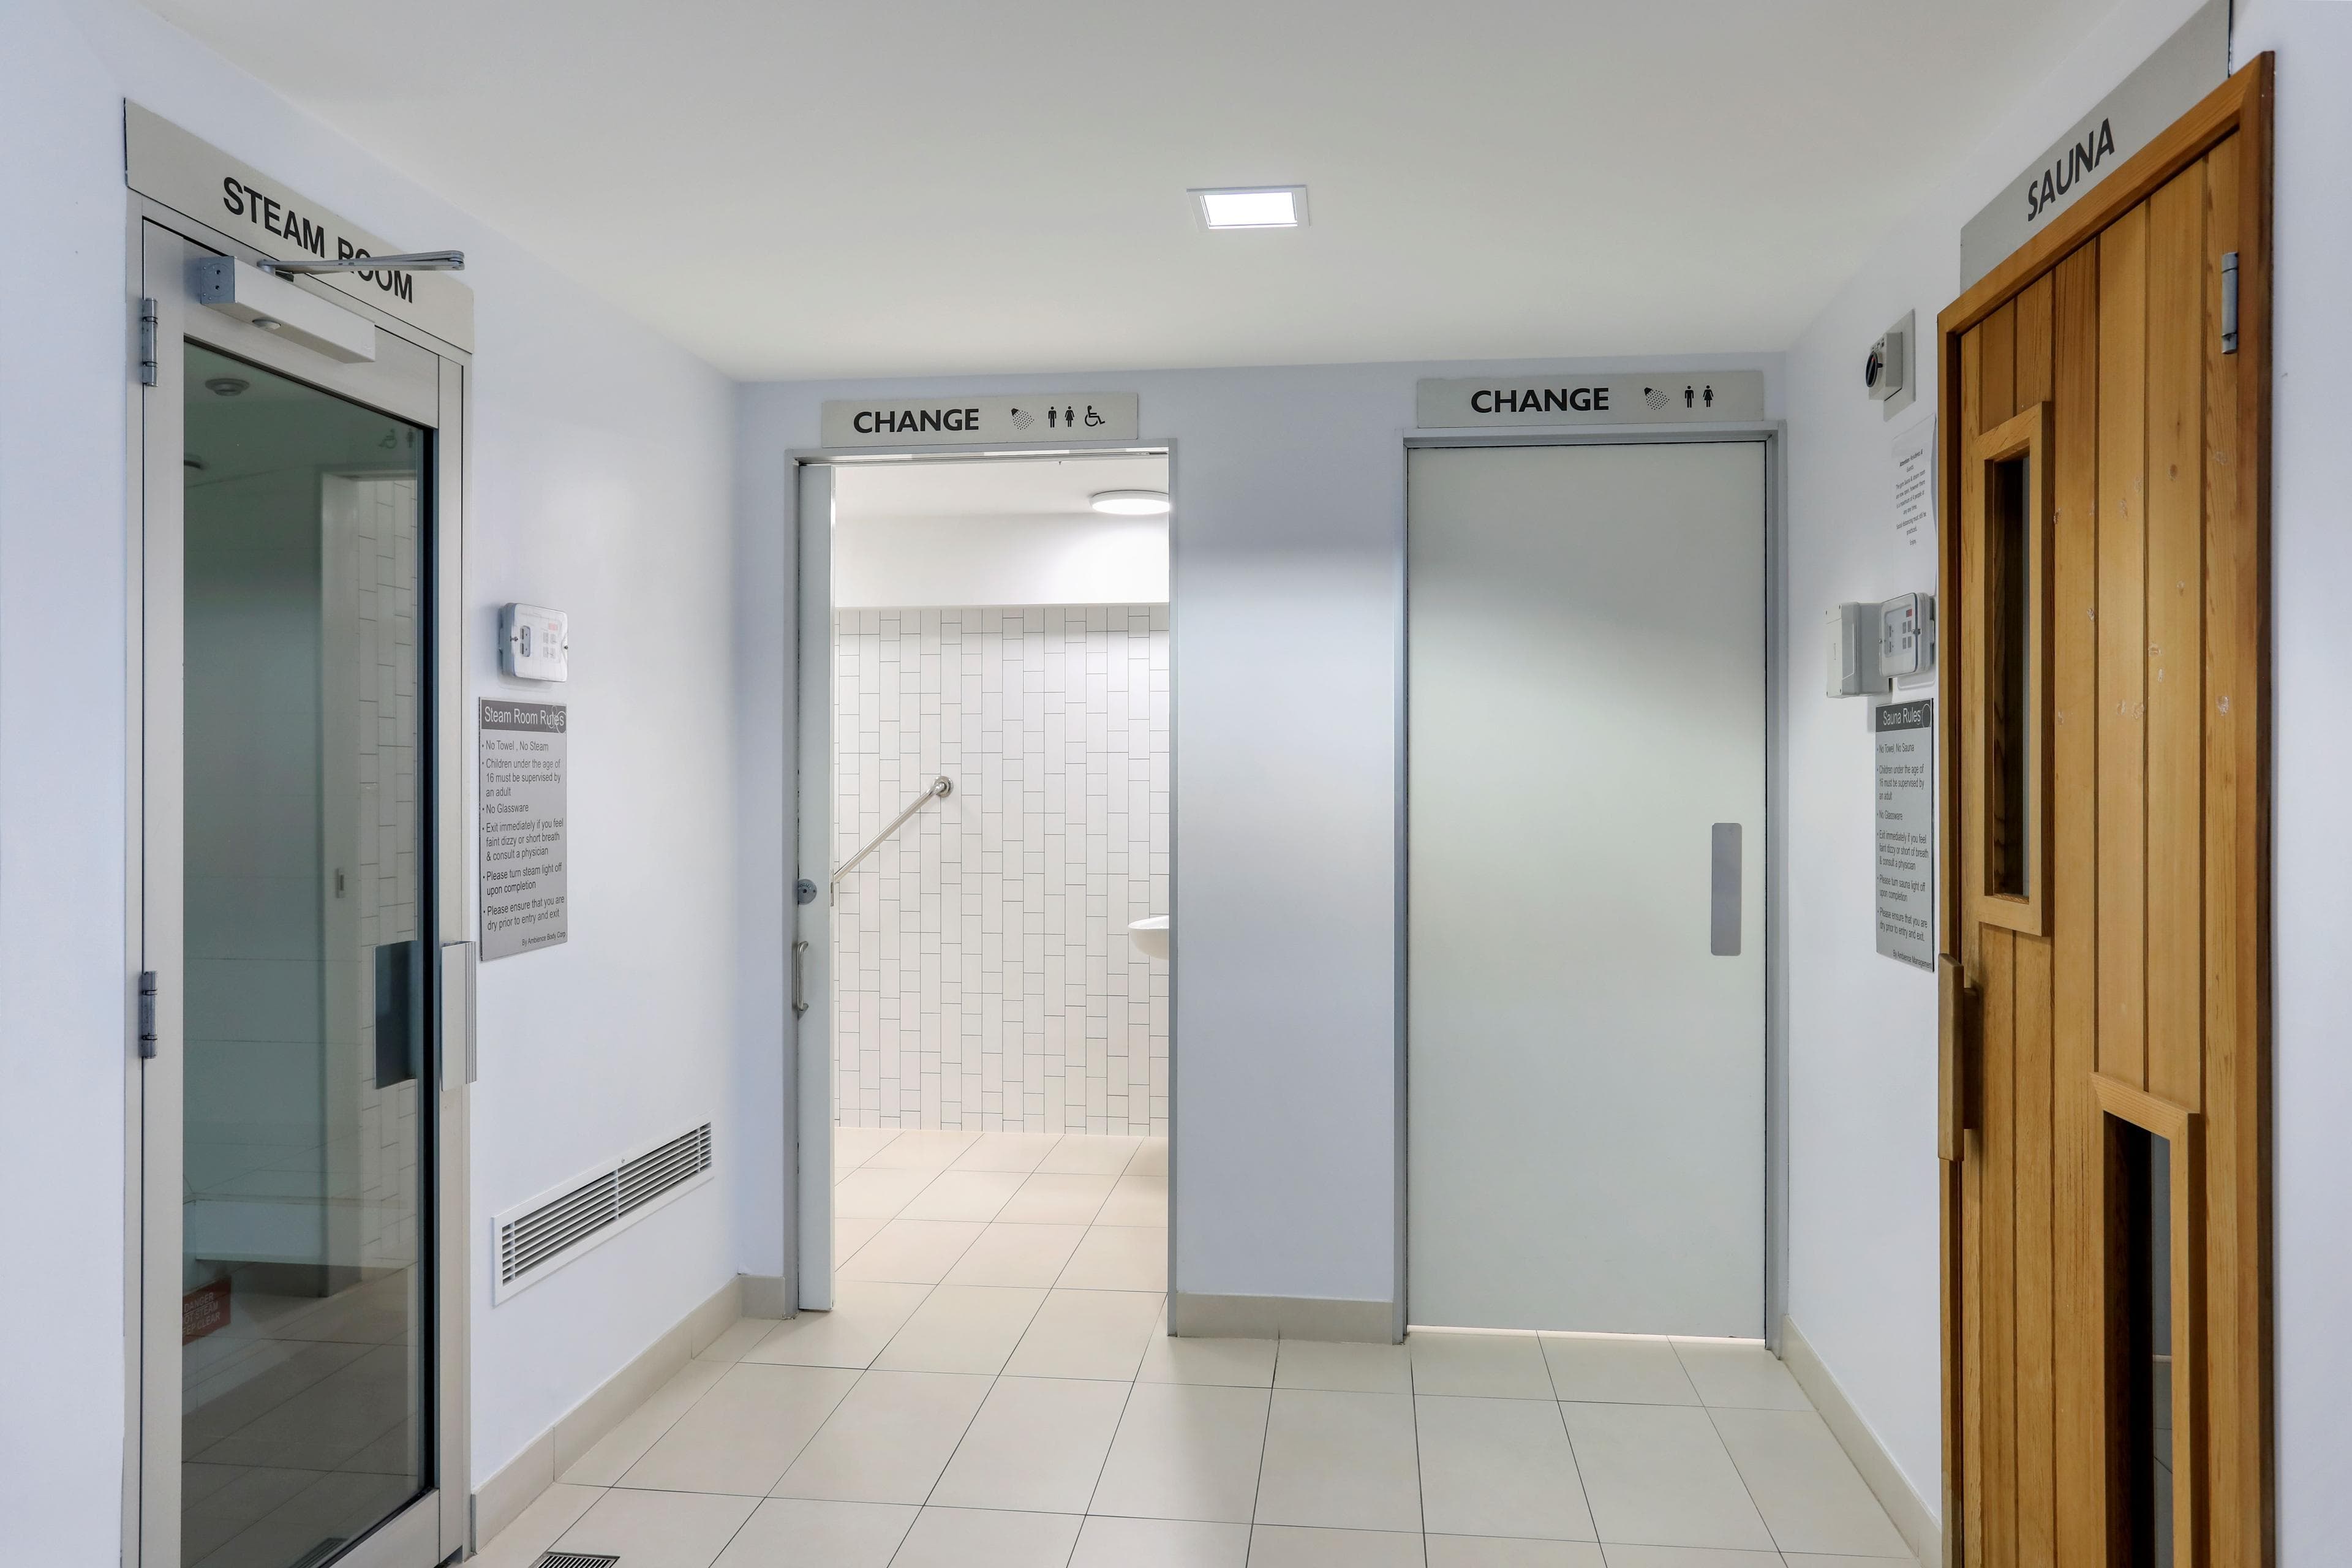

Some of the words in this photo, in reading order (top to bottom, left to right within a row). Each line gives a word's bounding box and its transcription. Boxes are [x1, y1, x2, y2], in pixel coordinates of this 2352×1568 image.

[2028, 118, 2114, 221] SAUNA
[223, 177, 325, 258] STEAM
[338, 236, 412, 304] ROOM
[1471, 388, 1608, 413] CHANGE
[854, 409, 979, 433] CHANGE
[484, 706, 511, 722] Steam
[514, 708, 538, 724] Room
[540, 710, 564, 726] Rules
[1883, 710, 1901, 725] Sauna
[1903, 707, 1921, 723] Rules
[486, 740, 495, 750] No
[520, 741, 528, 751] No
[530, 741, 549, 751] Steam
[1879, 744, 1883, 753] No
[1896, 744, 1901, 752] No
[1902, 742, 1914, 752] Sauna
[486, 758, 511, 768] Children
[514, 759, 530, 768] under
[532, 759, 541, 768] the
[543, 760, 553, 770] age
[555, 758, 561, 768] of
[1879, 765, 1893, 774] Children
[1894, 764, 1904, 774] under
[1920, 764, 1924, 773] of
[486, 772, 494, 782] 16
[496, 773, 511, 782] must
[512, 772, 519, 782] be
[522, 772, 552, 784] supervised
[554, 772, 560, 783] by
[1880, 778, 1883, 787] 16
[1893, 778, 1898, 787] be
[1898, 778, 1918, 790] supervised
[1920, 778, 1924, 790] by
[496, 787, 511, 796] adult
[486, 804, 495, 813] No
[497, 804, 529, 813] Glassware
[1879, 810, 1884, 819] No
[1885, 810, 1902, 820] Glassware
[486, 823, 498, 832] Exit
[500, 820, 535, 831] immediately
[537, 820, 540, 829] if
[541, 821, 552, 831] you
[554, 818, 564, 827] feel
[486, 837, 500, 846] faint
[501, 836, 517, 846] dizzy
[526, 834, 540, 843] short
[542, 832, 560, 842] breath
[1886, 831, 1907, 844] immediately
[1907, 833, 1910, 842] if
[486, 851, 491, 861] &
[493, 849, 514, 861] consult
[522, 846, 548, 859] physician
[1887, 844, 1896, 856] dizzy
[1901, 846, 1910, 856] short
[1911, 846, 1915, 856] of
[1916, 848, 1928, 858] breath
[1880, 856, 1882, 864] &
[1883, 858, 1894, 867] consult
[1899, 859, 1915, 870] physician
[487, 871, 508, 881] Please
[510, 869, 521, 878] turn
[523, 867, 540, 876] steam
[541, 864, 554, 876] light
[487, 886, 502, 897] upon
[504, 880, 536, 893] completion
[1880, 874, 1891, 885] Please
[1899, 880, 1910, 889] sauna
[1911, 881, 1920, 892] light
[1888, 891, 1907, 902] completion
[487, 906, 508, 916] Please
[510, 902, 530, 912] ensure
[532, 898, 543, 908] that
[544, 898, 554, 908] you
[487, 920, 497, 932] dry
[499, 918, 513, 930] prior
[521, 914, 536, 924] entry
[538, 910, 548, 921] and
[550, 908, 560, 918] exit
[1880, 907, 1891, 918] Please
[1892, 913, 1904, 922] ensure
[1894, 925, 1898, 933] to
[1899, 927, 1908, 939] entry
[527, 935, 546, 944] Ambience
[1893, 949, 1897, 959] By
[1898, 951, 1911, 962] Ambience
[185, 1292, 214, 1313] DANGER
[184, 1313, 193, 1324] OT
[195, 1301, 219, 1320] STEAM
[183, 1323, 196, 1335] EEP
[197, 1312, 221, 1330] CLEAR
